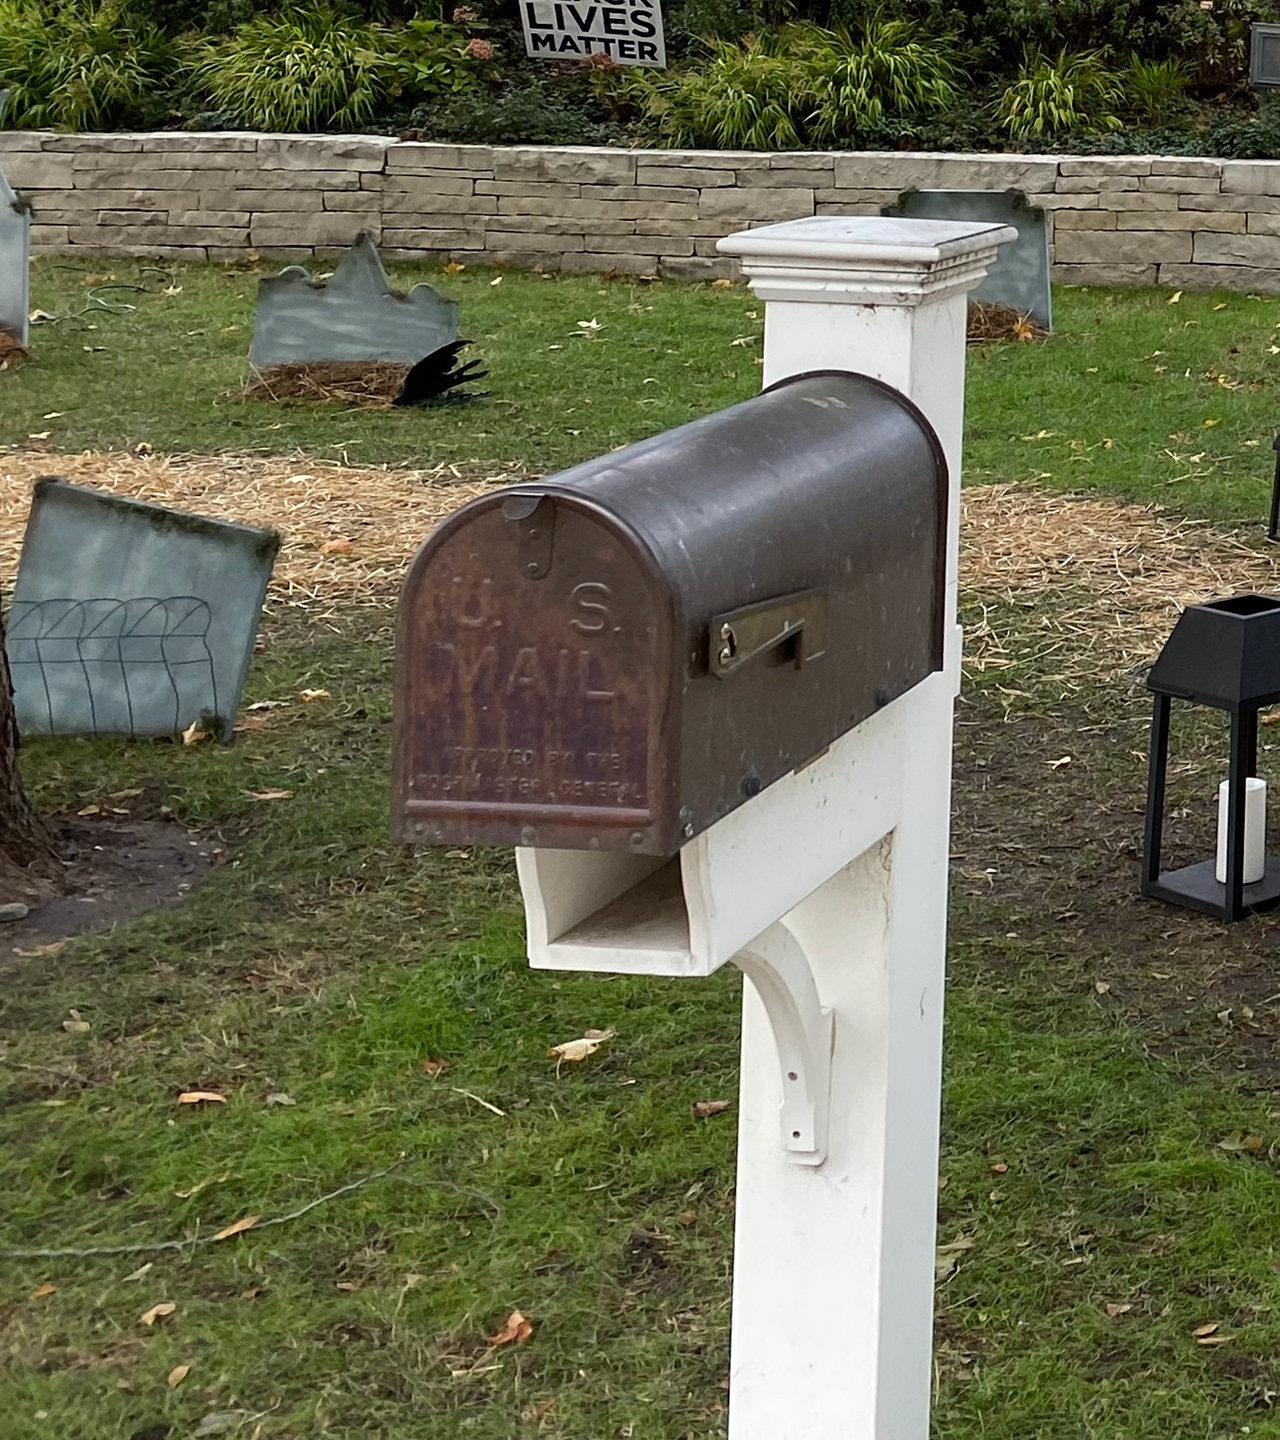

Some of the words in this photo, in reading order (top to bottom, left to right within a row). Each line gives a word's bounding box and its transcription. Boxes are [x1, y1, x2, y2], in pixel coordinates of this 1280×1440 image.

[525, 2, 657, 38] LIVES
[530, 33, 659, 62] MATTER
[430, 641, 617, 700] MAIL
